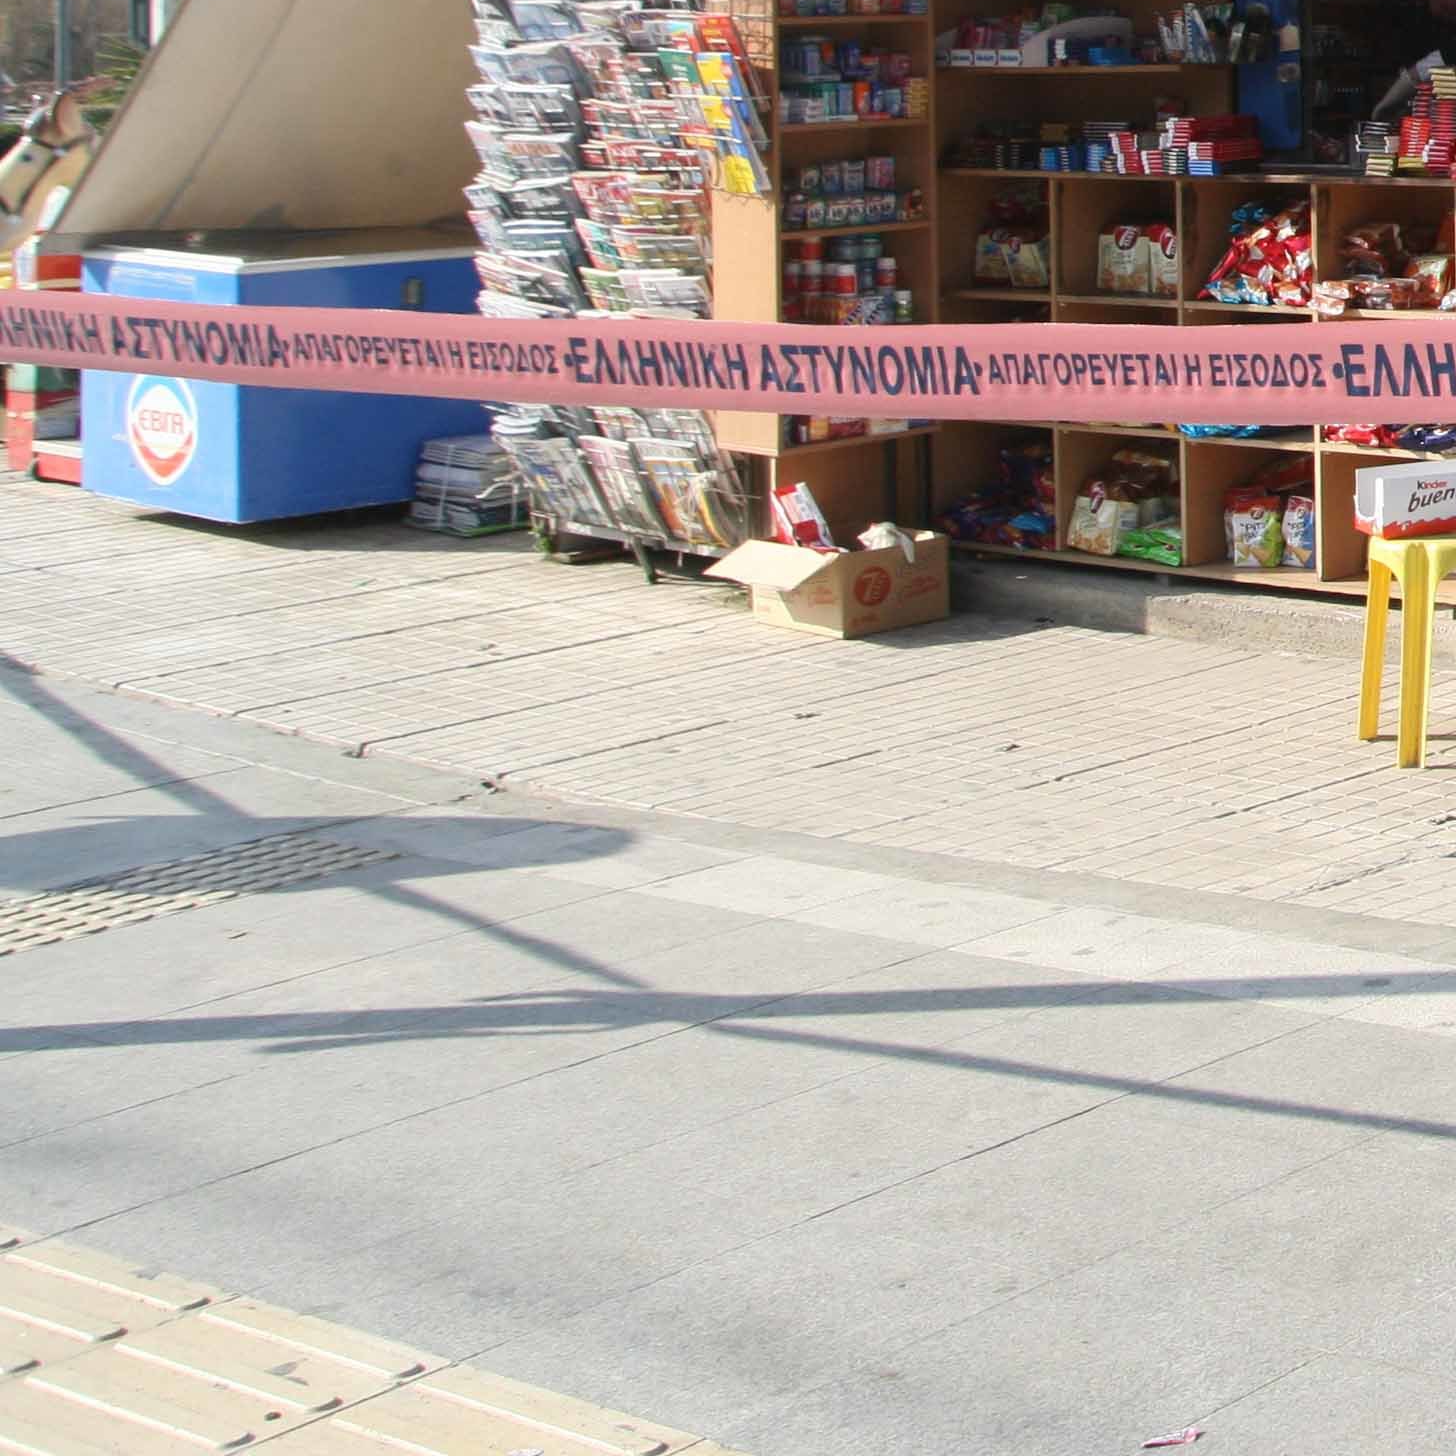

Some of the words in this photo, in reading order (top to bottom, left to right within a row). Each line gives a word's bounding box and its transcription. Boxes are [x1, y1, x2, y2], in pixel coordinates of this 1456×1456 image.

[110, 315, 289, 369] ΑΣΤΥΝΟΜΙΑ
[294, 333, 447, 369] ΑΠΑΓΟΡΕΥΕΤΑΙ
[449, 340, 465, 369] Η
[469, 341, 560, 376] ΕΙΣΟΔΟΣ
[568, 337, 750, 391] ΕΛΛΗΝΙΚΗ
[760, 345, 980, 396] ΑΣΤΥΝΟΜΙΑ
[988, 352, 1180, 386] ΑΠΑΓΟΡΕΥΕΤΑΙ
[1184, 353, 1201, 386] Η
[1210, 353, 1327, 388] ΕΙΣΟΔΟΣ
